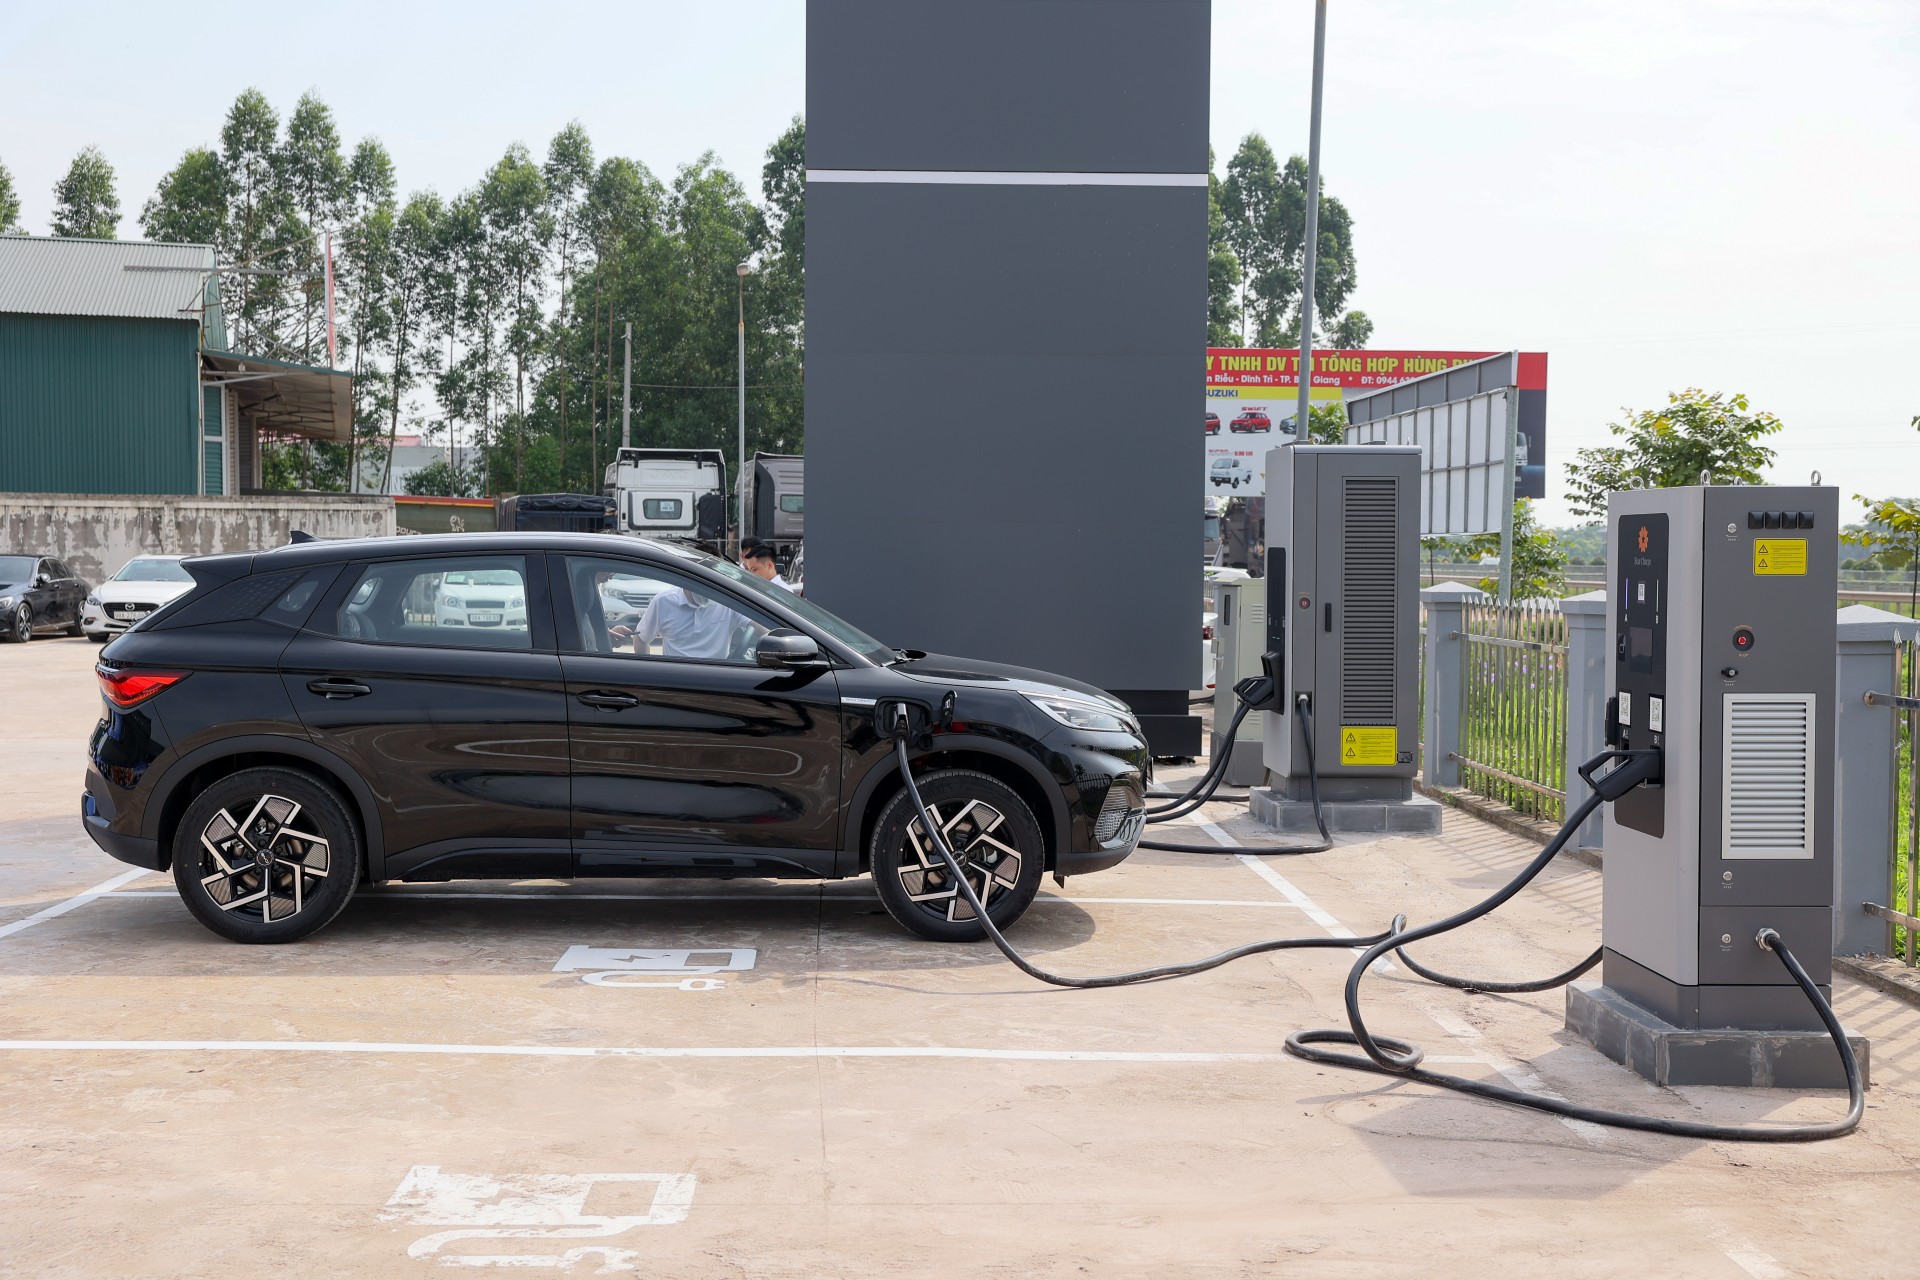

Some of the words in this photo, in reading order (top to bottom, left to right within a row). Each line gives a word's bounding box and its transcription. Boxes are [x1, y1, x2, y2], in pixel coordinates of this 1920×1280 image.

[1219, 355, 1262, 372] TNHH
[1266, 356, 1287, 372] DV
[1320, 351, 1362, 373] TỔNG
[1366, 356, 1399, 376] HỢP
[1403, 355, 1448, 373] HÙNG
[1313, 375, 1341, 386] Giang
[1376, 377, 1398, 385] 0944
